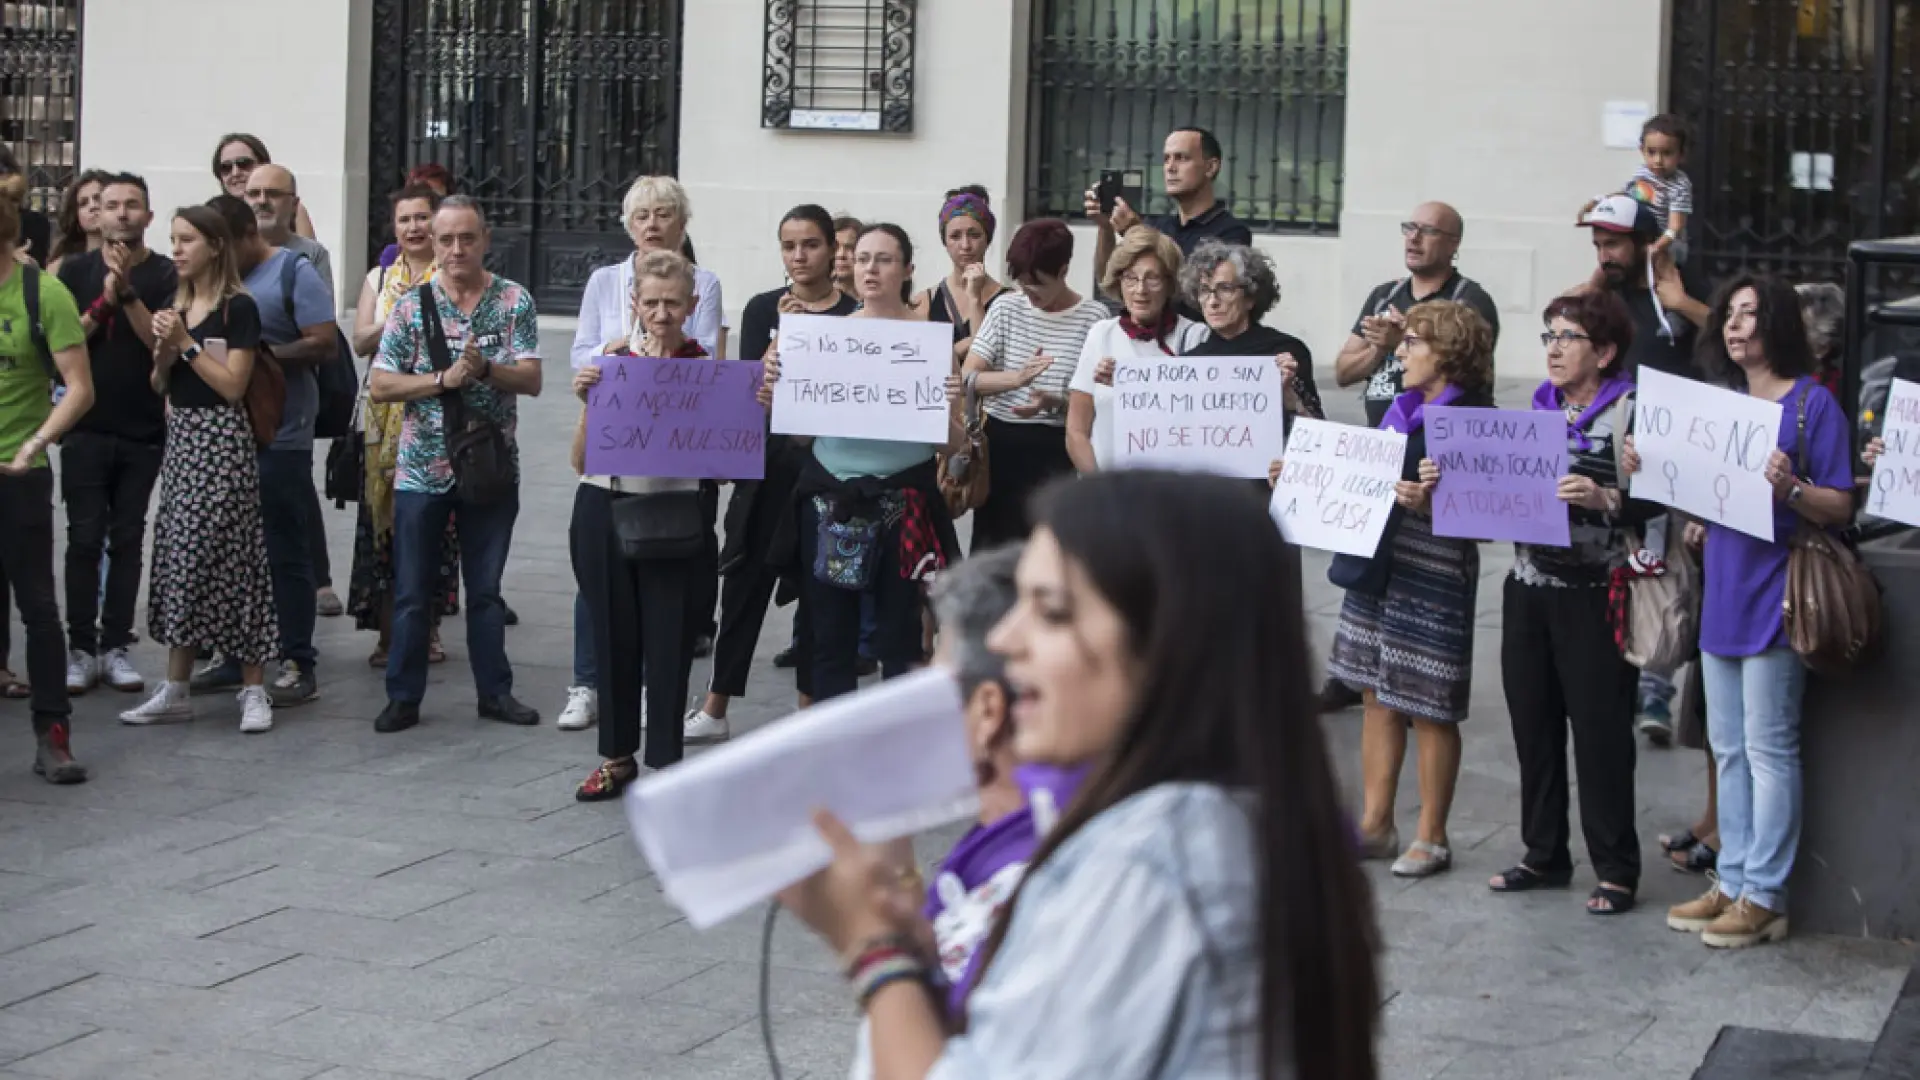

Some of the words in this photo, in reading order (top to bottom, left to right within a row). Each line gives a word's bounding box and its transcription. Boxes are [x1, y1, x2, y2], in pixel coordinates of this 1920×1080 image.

[653, 363, 730, 385] CALLE
[1117, 365, 1150, 383] CON
[1157, 364, 1198, 382] ROPA
[1207, 365, 1220, 382] O
[1231, 365, 1264, 382] SIN
[1170, 393, 1194, 413] MI
[1201, 392, 1268, 413] CUERPO
[599, 424, 652, 450] SON
[1128, 427, 1159, 455] NO
[1167, 426, 1192, 447] SE
[1200, 425, 1253, 448] TOCA
[1434, 416, 1454, 440] SI
[1464, 420, 1518, 440] TOCAN
[1523, 422, 1538, 441] A
[1640, 405, 1672, 437] NO
[1688, 416, 1717, 452] ES
[1724, 420, 1769, 472] NO
[1474, 453, 1504, 480] NOS
[1506, 453, 1560, 479] TOCAN
[1285, 498, 1297, 516] A
[1321, 499, 1372, 533] CASA
[1441, 491, 1460, 517] A
